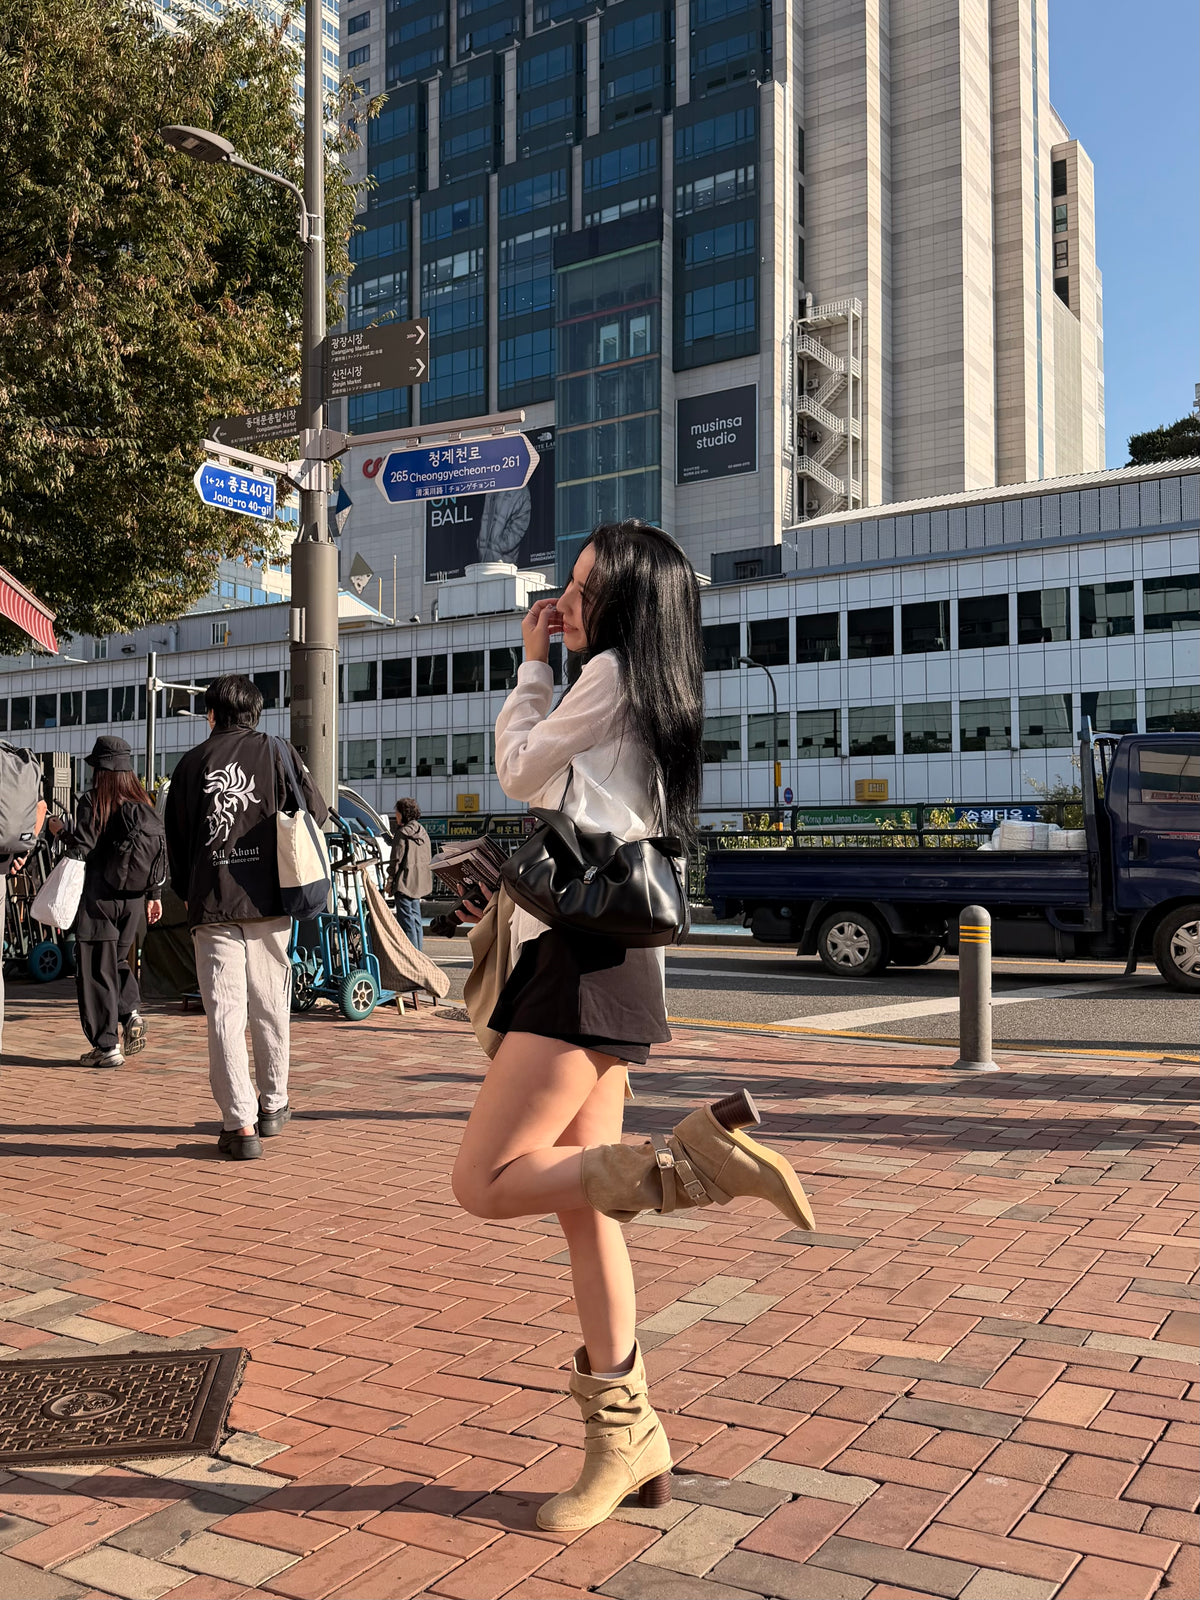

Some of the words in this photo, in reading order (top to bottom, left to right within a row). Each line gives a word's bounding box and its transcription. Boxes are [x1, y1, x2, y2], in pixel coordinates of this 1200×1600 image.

[331, 333, 363, 349] 광장시장
[355, 344, 370, 352] Market
[332, 366, 363, 380] 신진시장
[245, 409, 297, 428] 동대문종합시장
[691, 416, 742, 435] musinsa
[696, 431, 737, 449] studio
[428, 446, 482, 468] 청계천로
[390, 470, 408, 483] 265
[409, 464, 500, 483] Cheonggyecheon-ro
[502, 455, 520, 469] 261
[215, 478, 225, 488] 24
[228, 475, 272, 503] 종로40길
[213, 491, 247, 509] Jong-ro
[248, 501, 272, 516] 40-gil
[431, 505, 473, 527] BALL
[967, 808, 1023, 823] 송월타올
[212, 849, 225, 860] All
[231, 846, 259, 857] About
